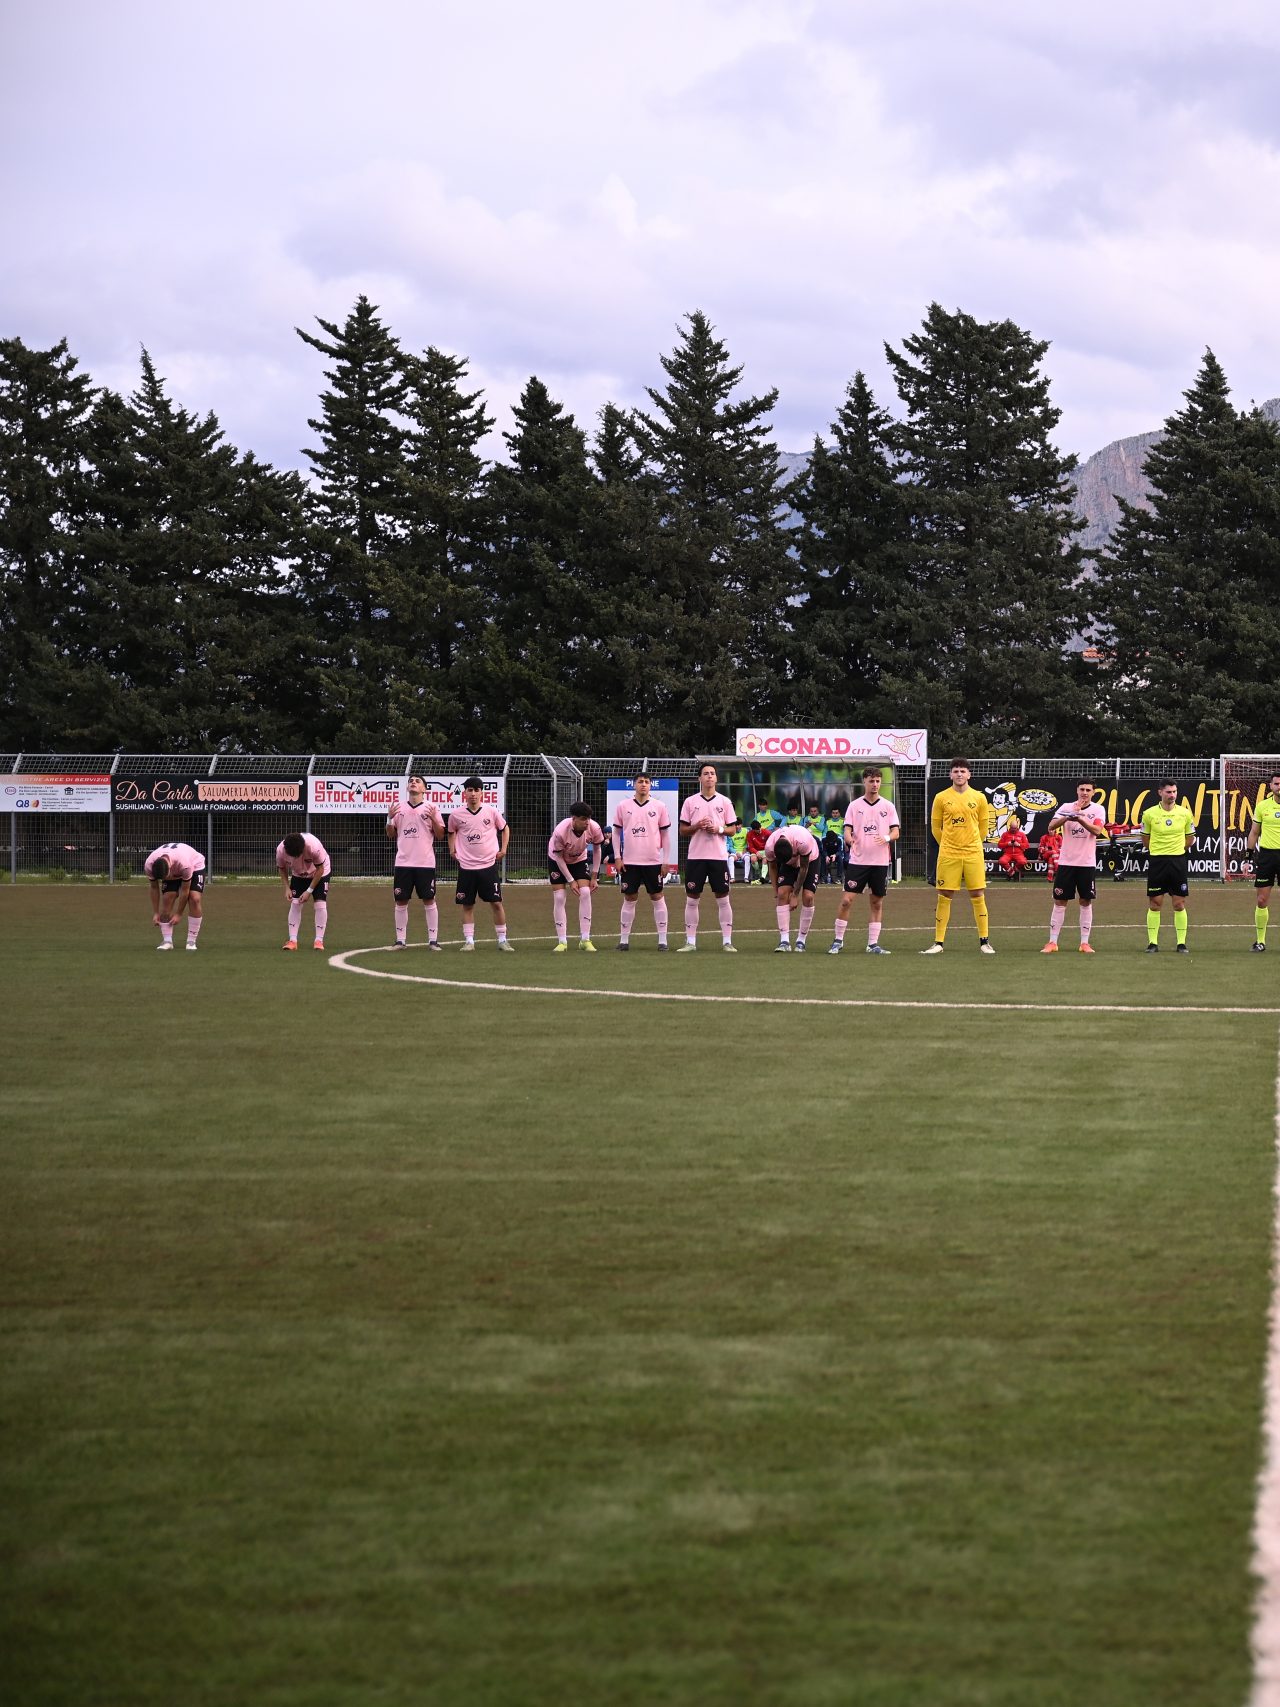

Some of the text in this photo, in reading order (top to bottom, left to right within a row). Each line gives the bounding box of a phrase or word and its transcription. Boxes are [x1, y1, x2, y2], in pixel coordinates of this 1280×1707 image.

[765, 737, 851, 755] CONAD
[116, 780, 194, 802] Da Carlo
[315, 780, 399, 803] STOCK HOUSE
[425, 791, 453, 803] TOCK
[16, 799, 29, 808] Q8
